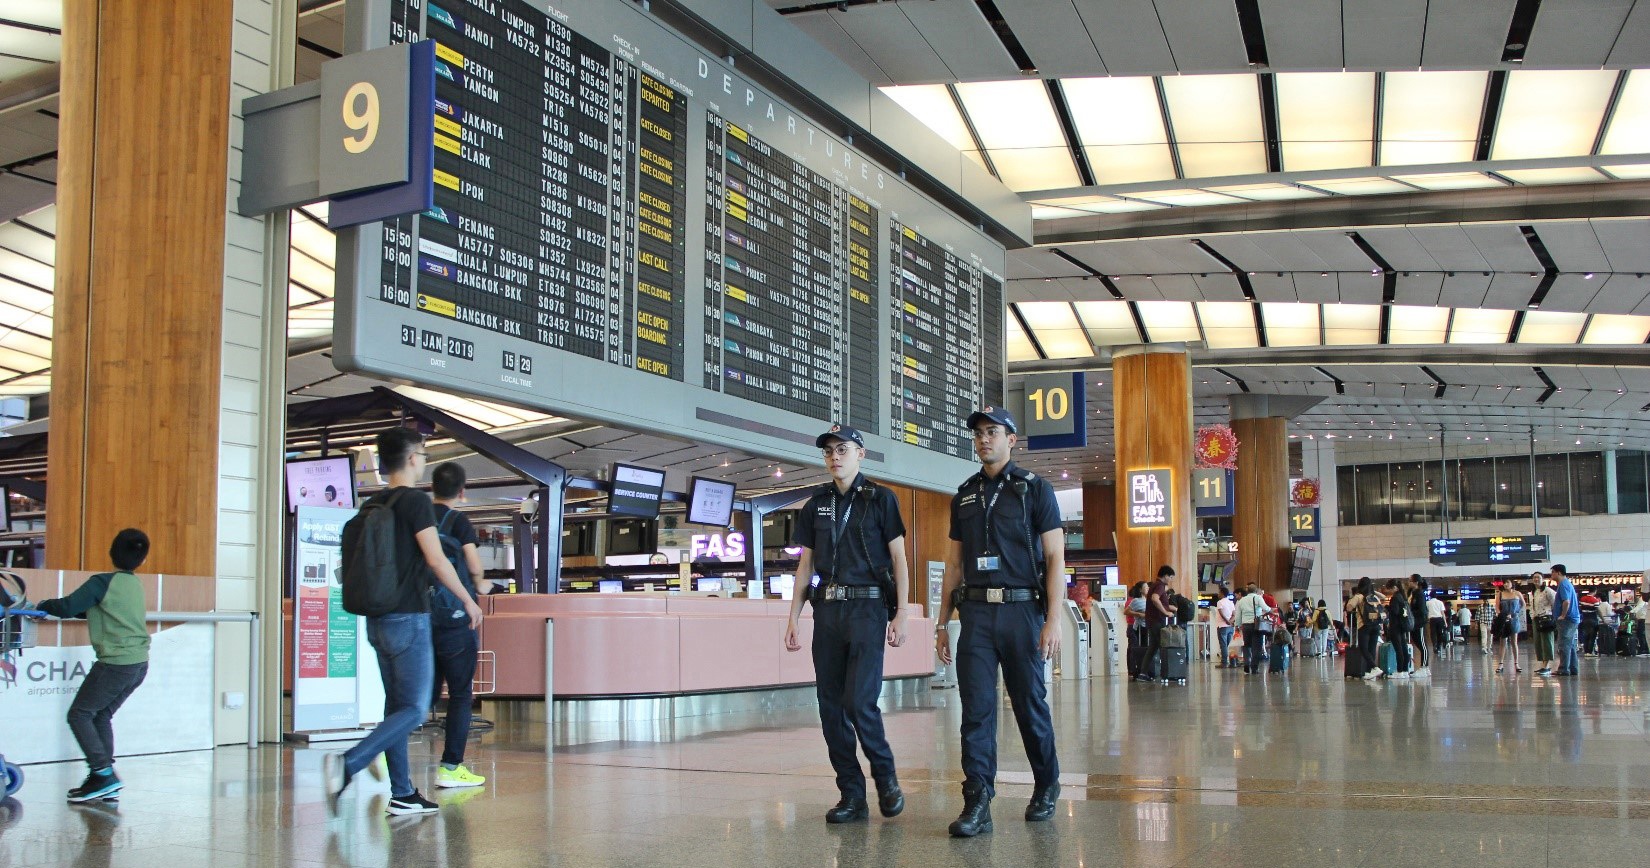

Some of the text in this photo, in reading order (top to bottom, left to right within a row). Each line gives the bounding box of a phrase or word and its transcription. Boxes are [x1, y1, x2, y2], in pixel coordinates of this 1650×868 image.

[501, 8, 534, 38] LUMPUR
[548, 5, 569, 22] FLIGHT
[464, 23, 493, 48] HANOI
[506, 28, 539, 56] VA5732
[463, 57, 493, 83] PERTH
[463, 74, 498, 103] YANGON
[342, 82, 380, 154] 9
[462, 111, 503, 139] JAKARTA
[698, 58, 884, 189] DEPARTURES
[461, 127, 483, 148] BALI
[460, 145, 490, 168] CLARK
[460, 180, 483, 201] IPOH
[458, 215, 494, 240] PENANG
[458, 233, 493, 256] VA5747
[499, 248, 533, 270] SQ5306
[457, 251, 487, 273] KUALA
[493, 263, 527, 286] LUMPUR
[456, 269, 521, 301] BANGKOK-BKK
[455, 305, 520, 335] BANGKOK-BKK
[430, 358, 446, 368] DATE
[501, 375, 532, 388] LOCAL TIME
[1028, 387, 1068, 421] 10
[1207, 438, 1225, 457] 春
[614, 489, 658, 500] SERVICE COUNTER
[1200, 478, 1220, 498] 11
[1299, 486, 1313, 499] 福
[1133, 505, 1164, 516] FAST
[303, 522, 322, 531] Apply
[1293, 514, 1313, 530] 12
[1228, 542, 1239, 552] 12
[1602, 576, 1643, 585] COFFEE
[27, 661, 95, 682] CHA
[28, 686, 60, 697] airport
